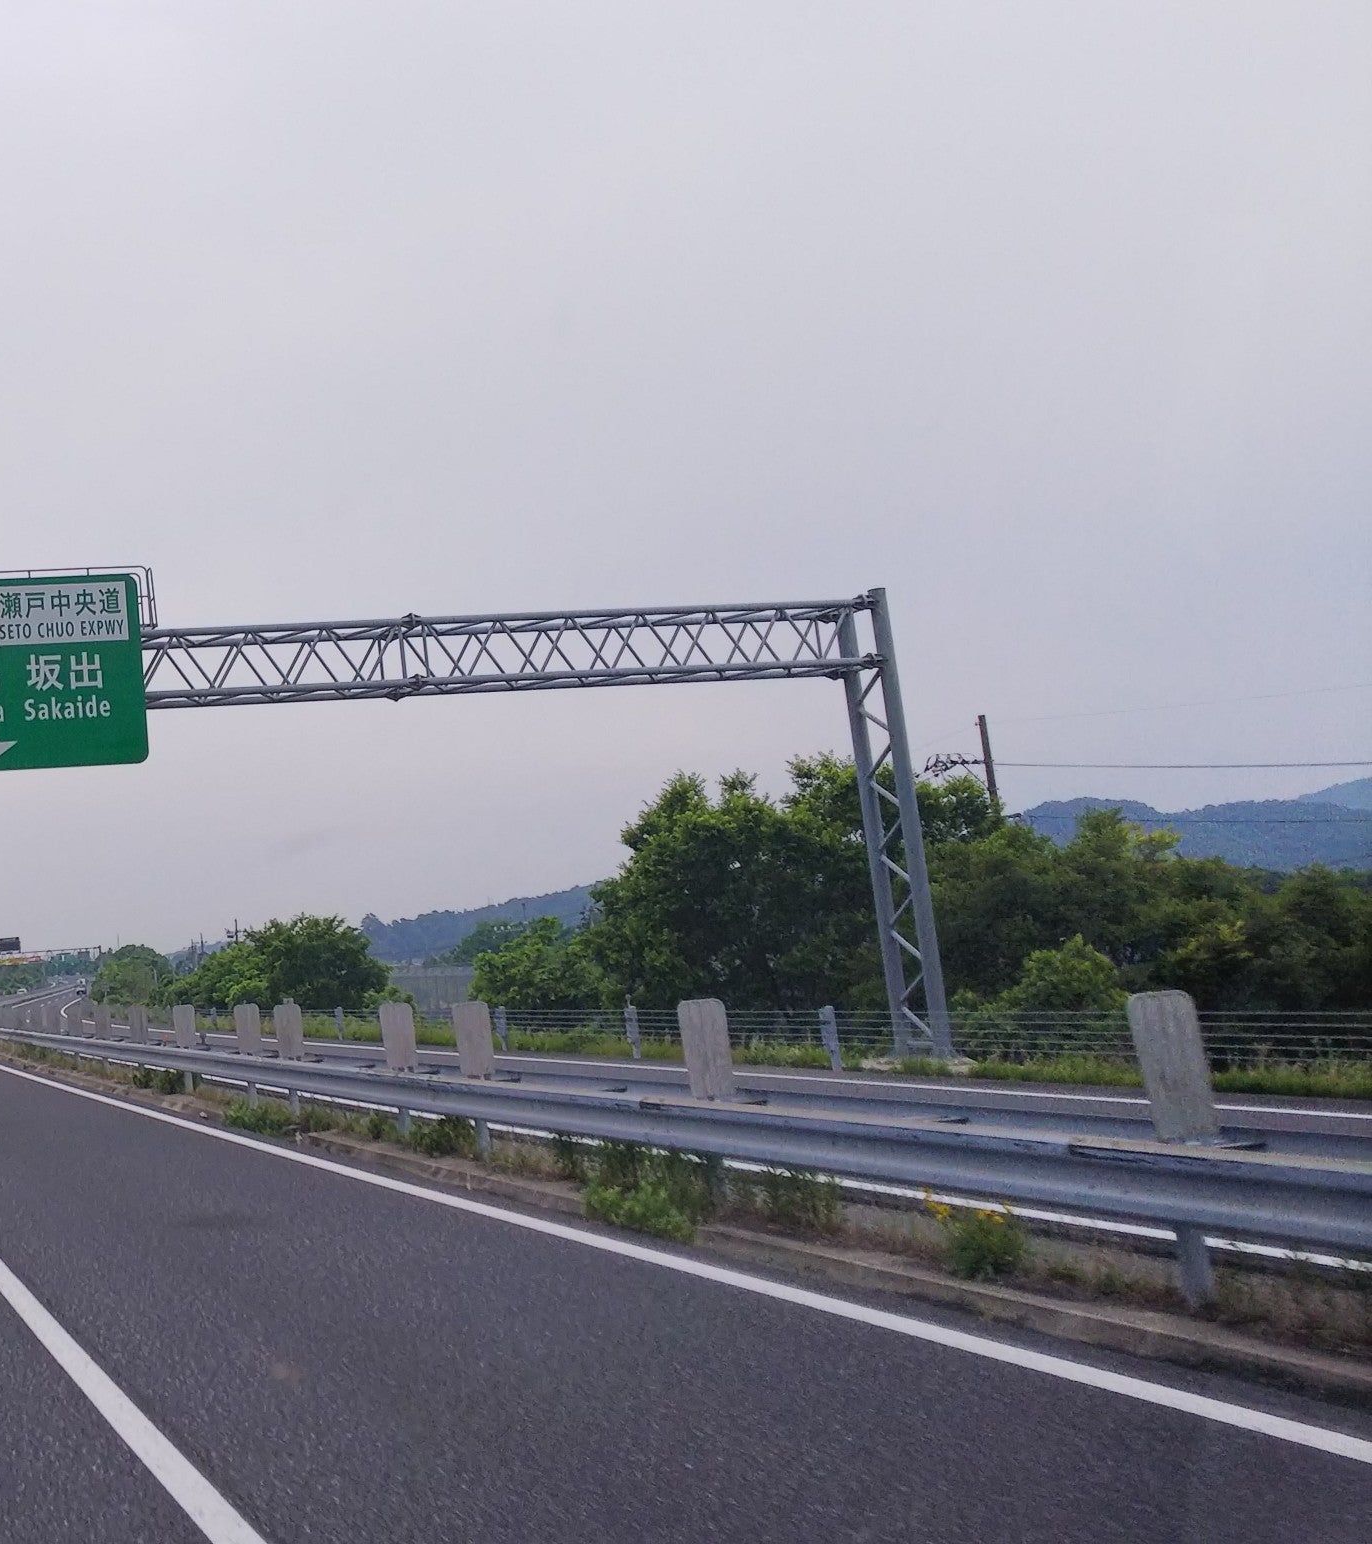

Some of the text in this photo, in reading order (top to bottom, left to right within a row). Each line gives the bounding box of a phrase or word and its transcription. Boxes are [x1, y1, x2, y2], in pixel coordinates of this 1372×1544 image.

[0, 588, 122, 619] 瀬戸中央道
[0, 618, 124, 640] SETO CHUO EXPWY
[26, 651, 104, 691] 坂出
[24, 695, 111, 722] Sakaide
